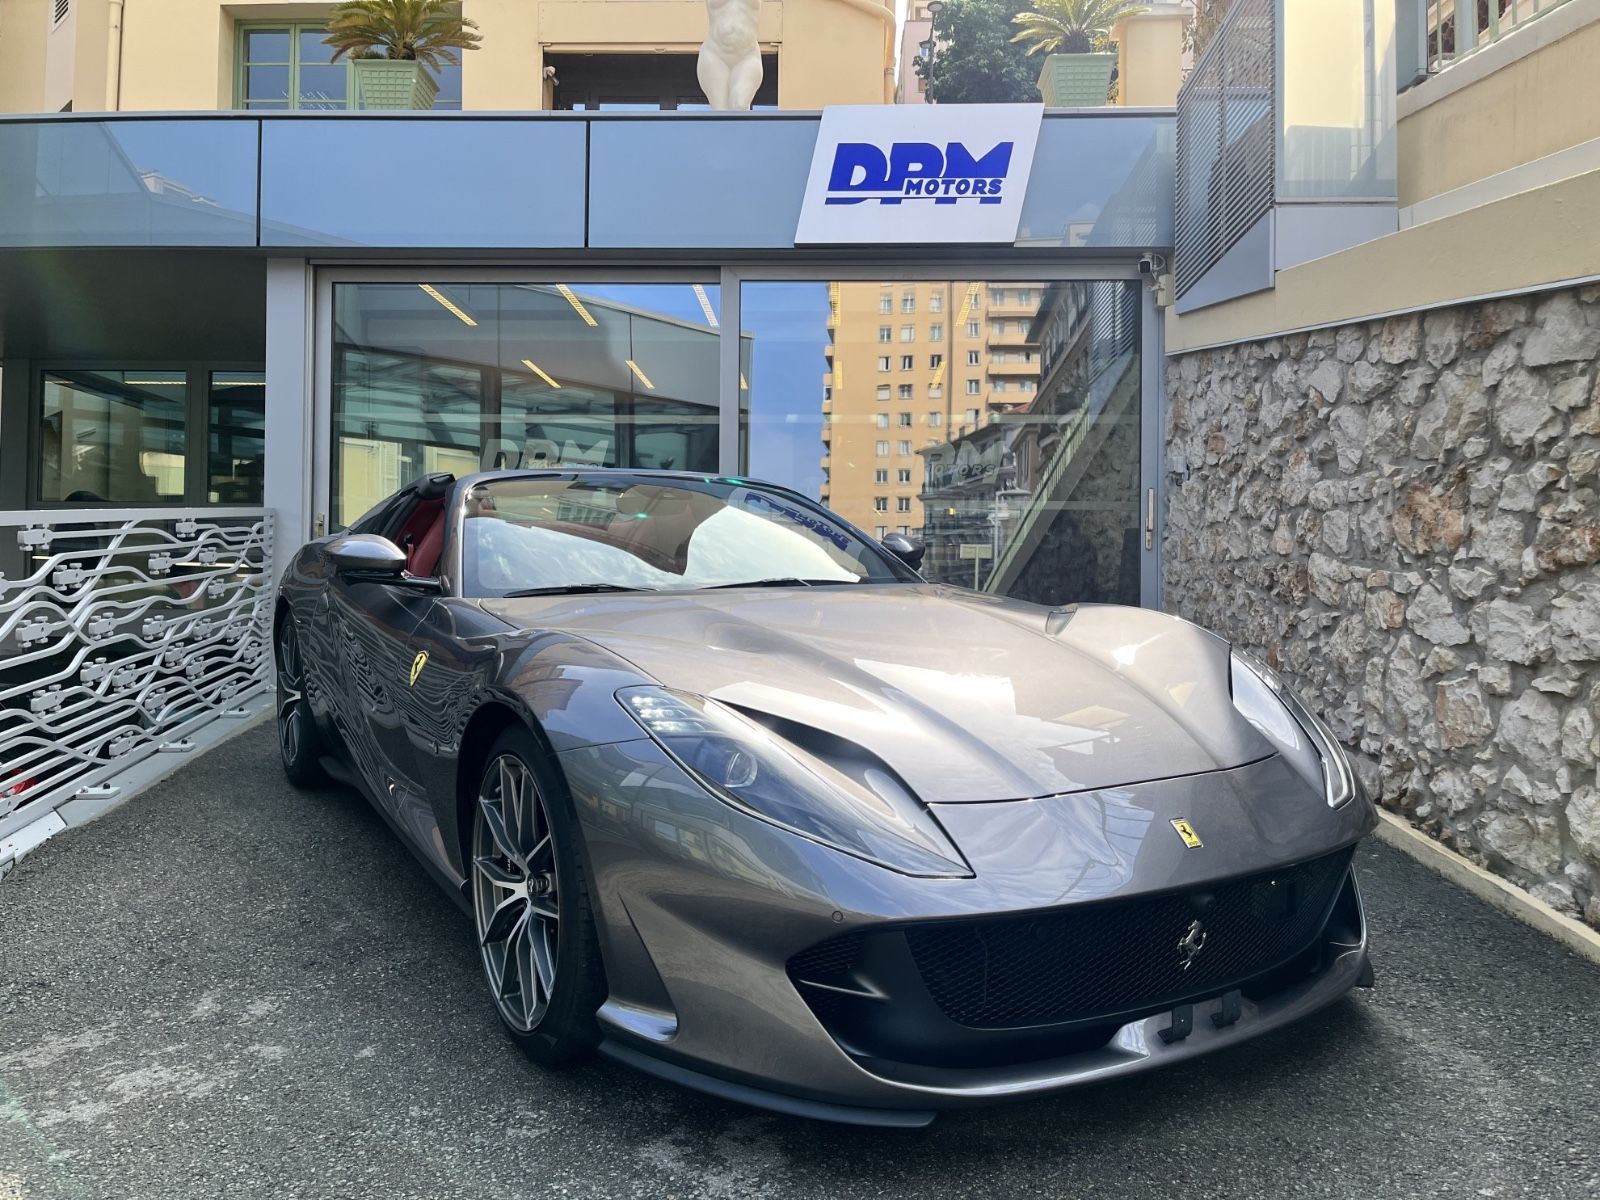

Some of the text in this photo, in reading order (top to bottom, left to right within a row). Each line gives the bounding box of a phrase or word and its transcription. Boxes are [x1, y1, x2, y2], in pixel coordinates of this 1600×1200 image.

[825, 142, 1014, 205] DPM
[904, 178, 1003, 195] MOTORS
[480, 438, 609, 471] DPM
